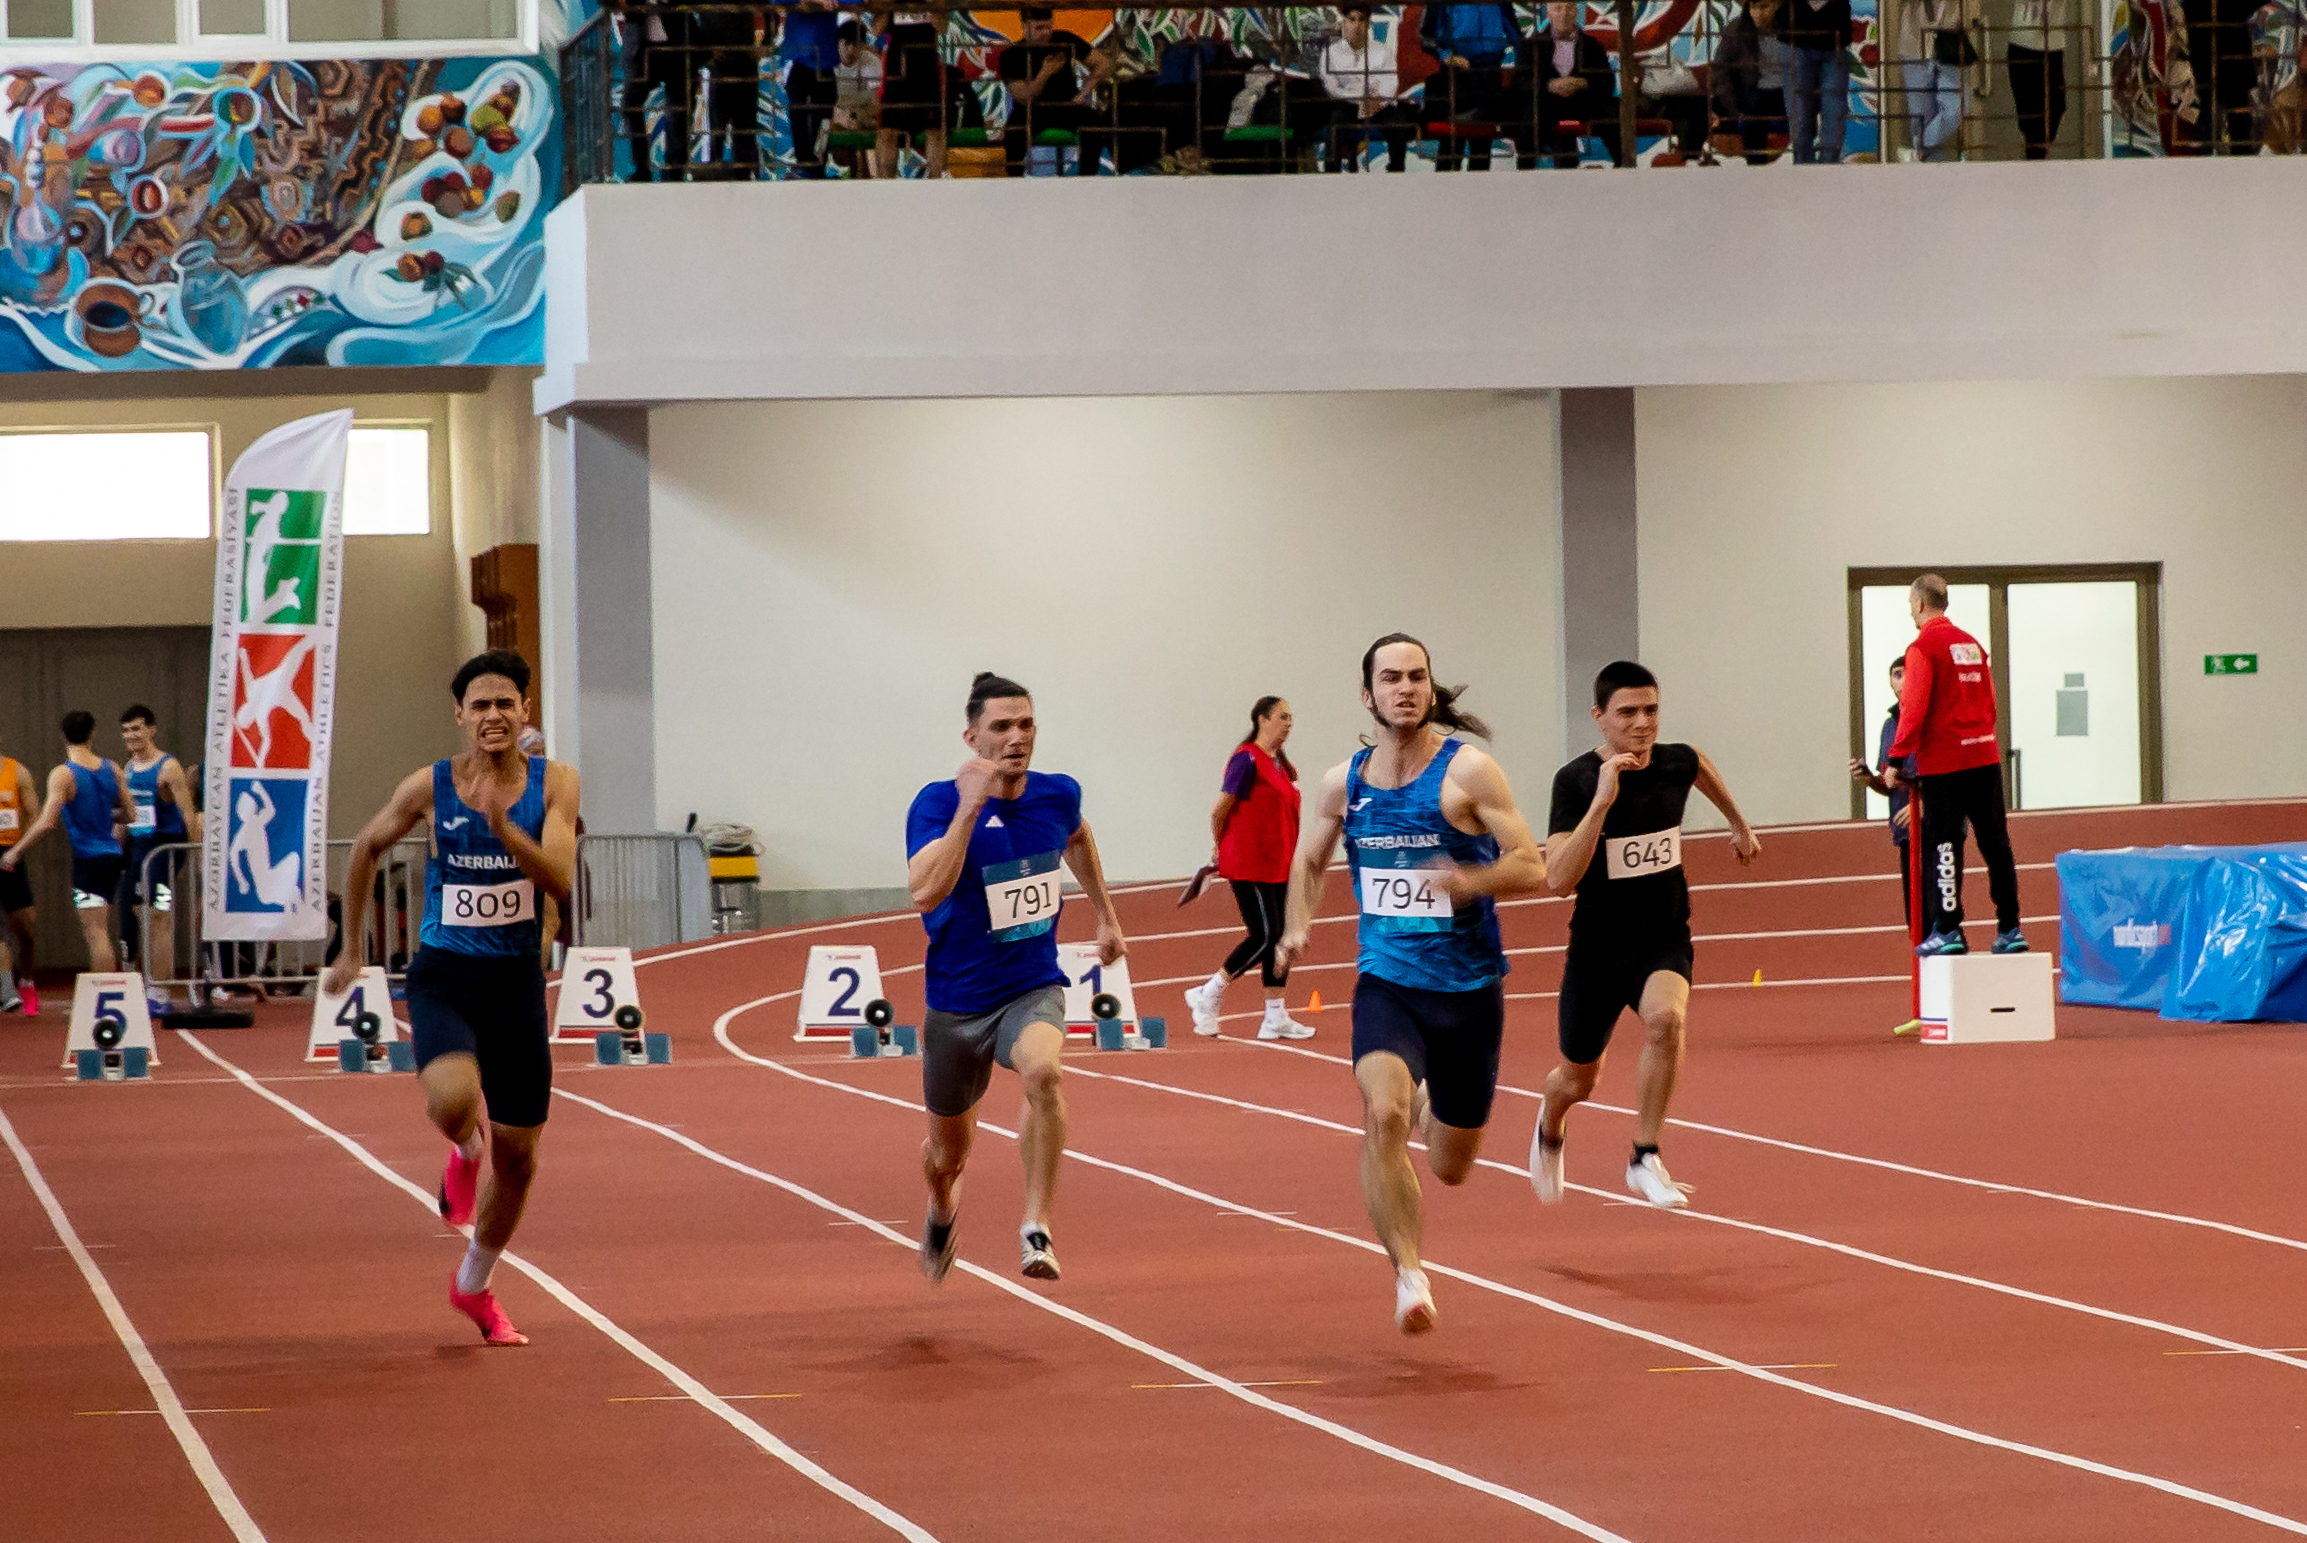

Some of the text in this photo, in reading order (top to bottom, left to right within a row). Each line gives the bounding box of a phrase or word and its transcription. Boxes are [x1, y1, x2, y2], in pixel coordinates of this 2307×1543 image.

[447, 853, 519, 870] AZERBAIJ
[1623, 837, 1672, 869] 643
[1372, 878, 1436, 910] 794
[1936, 841, 1957, 912] adidas
[455, 889, 521, 919] 809
[1004, 882, 1051, 918] 791
[582, 968, 615, 1019] 3
[827, 966, 860, 1017] 2
[1079, 963, 1101, 996] 1
[94, 991, 127, 1045] 5
[335, 986, 364, 1027] 4
